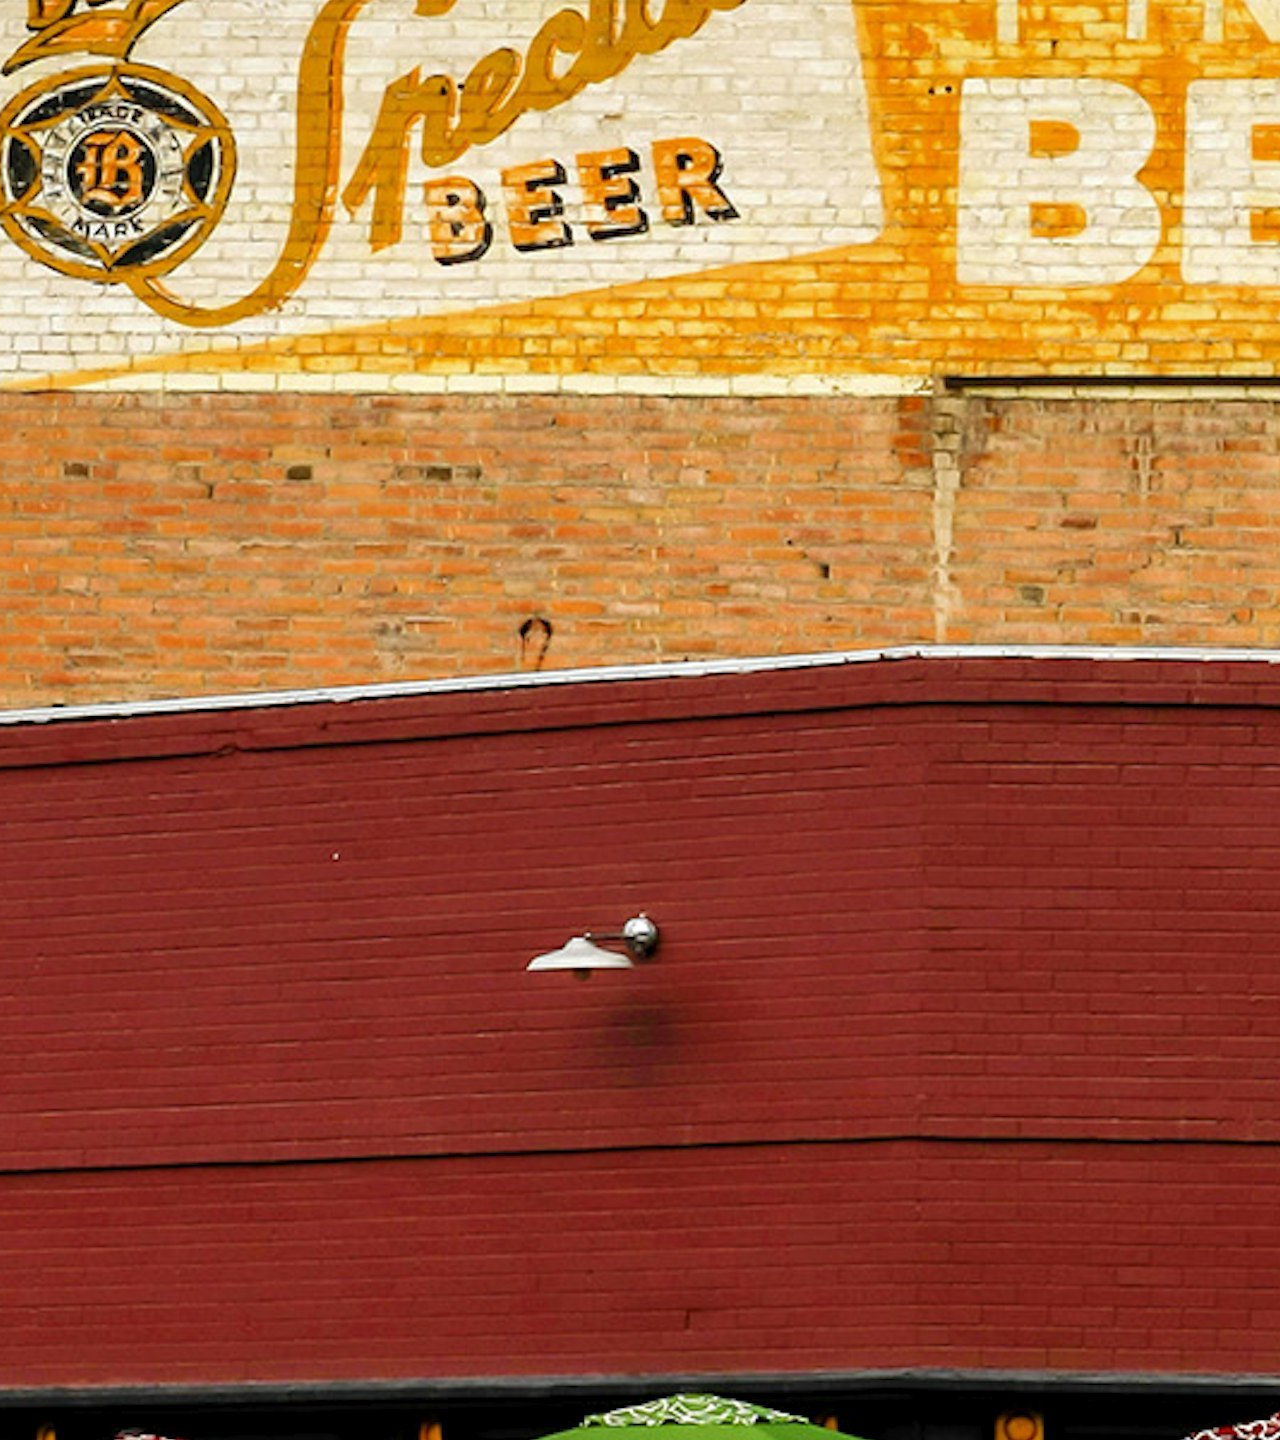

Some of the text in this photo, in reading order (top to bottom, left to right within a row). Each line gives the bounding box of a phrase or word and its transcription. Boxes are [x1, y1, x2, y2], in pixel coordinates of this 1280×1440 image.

[77, 105, 144, 122] TRADE
[430, 136, 738, 266] BEER
[71, 217, 145, 240] MARK
